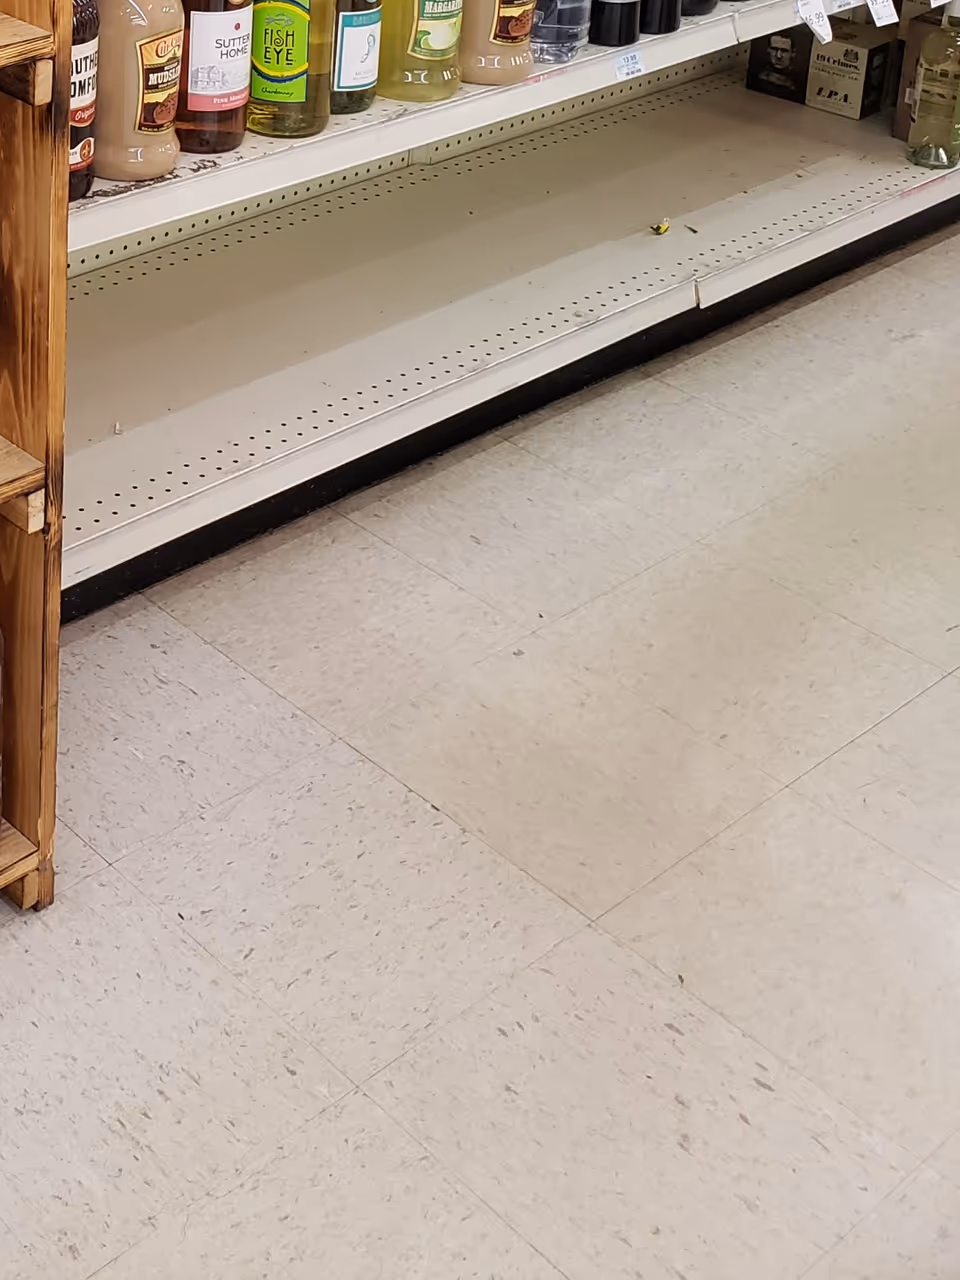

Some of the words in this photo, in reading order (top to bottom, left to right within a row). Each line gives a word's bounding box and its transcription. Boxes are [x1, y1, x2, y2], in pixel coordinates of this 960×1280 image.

[214, 33, 250, 49] SUTTER
[263, 28, 295, 49] FISH
[220, 44, 248, 59] HOME
[263, 46, 295, 66] EYE
